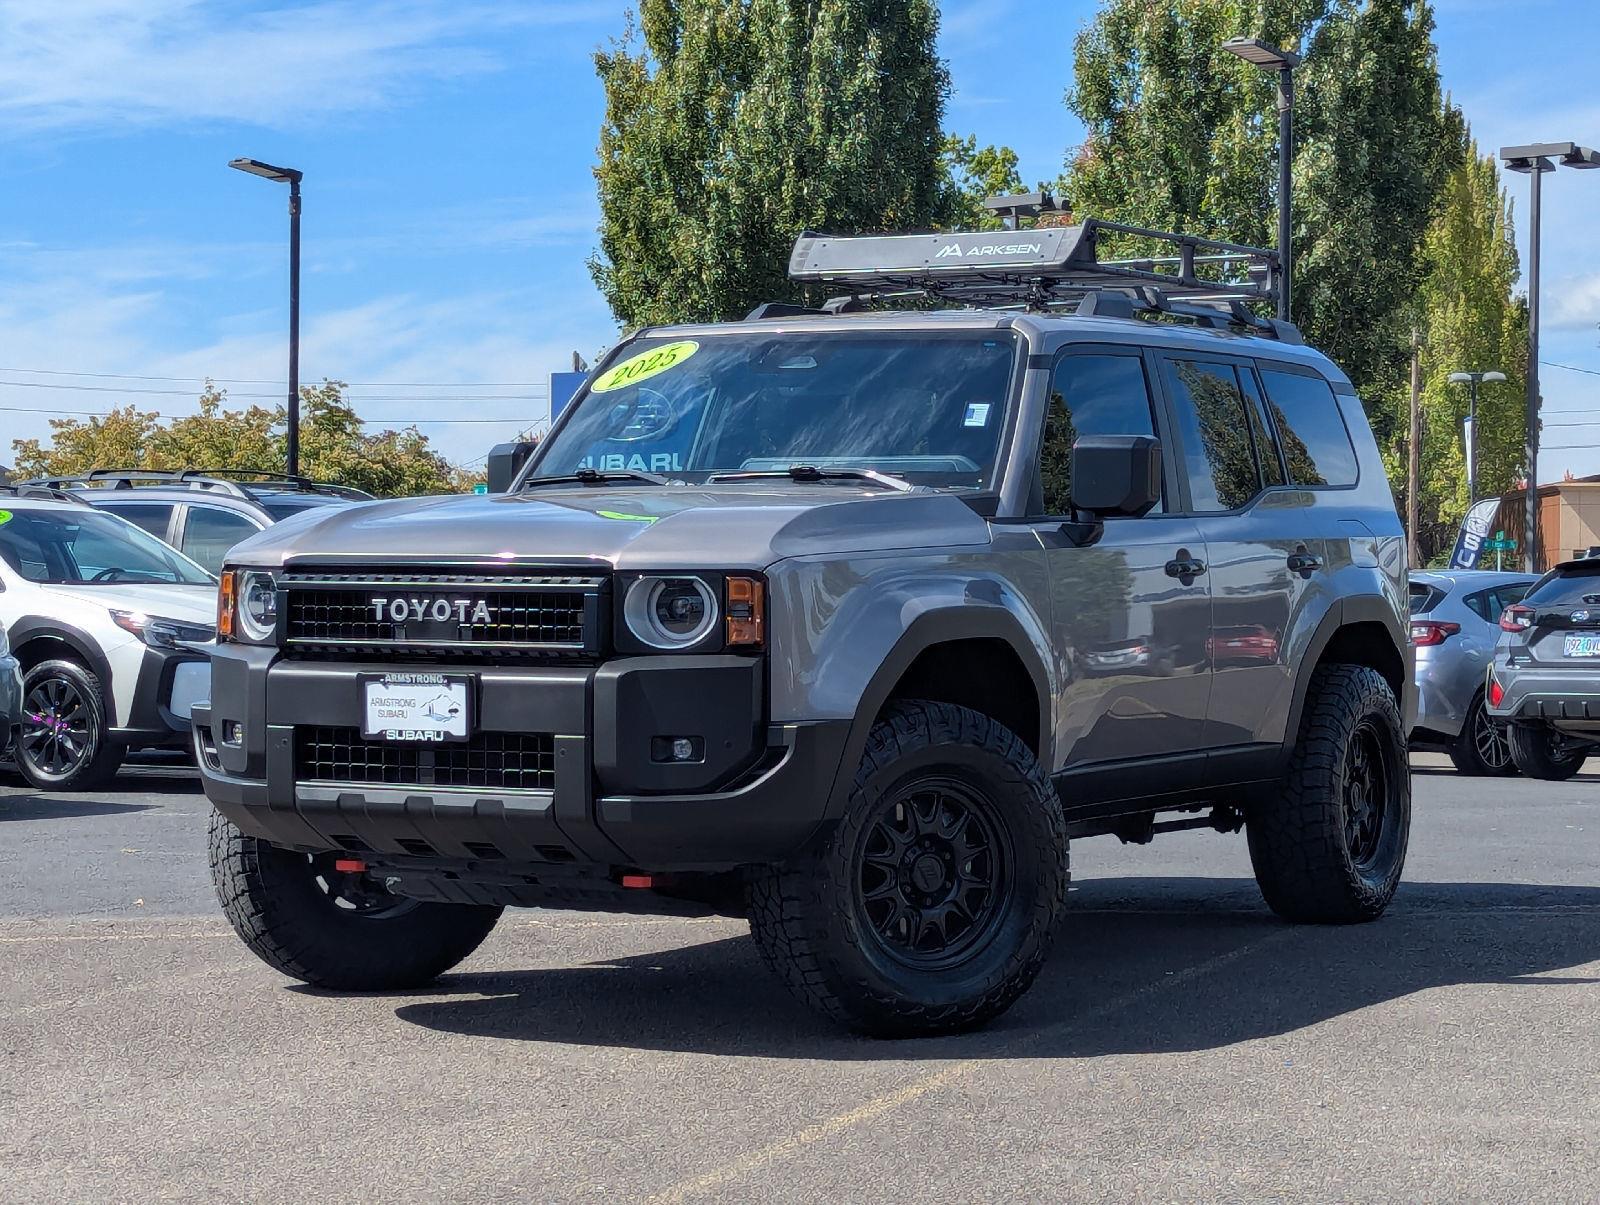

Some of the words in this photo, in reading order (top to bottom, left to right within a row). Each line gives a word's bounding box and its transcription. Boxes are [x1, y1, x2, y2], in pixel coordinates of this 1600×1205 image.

[966, 244, 1041, 256] ARKSEN
[608, 346, 681, 387] 2025
[371, 598, 492, 622] TOYOTA
[385, 673, 444, 684] ARMSTRONG
[370, 698, 416, 707] ARMSTRONG
[377, 709, 408, 718] SUBARU
[386, 730, 444, 741] SUBARU
